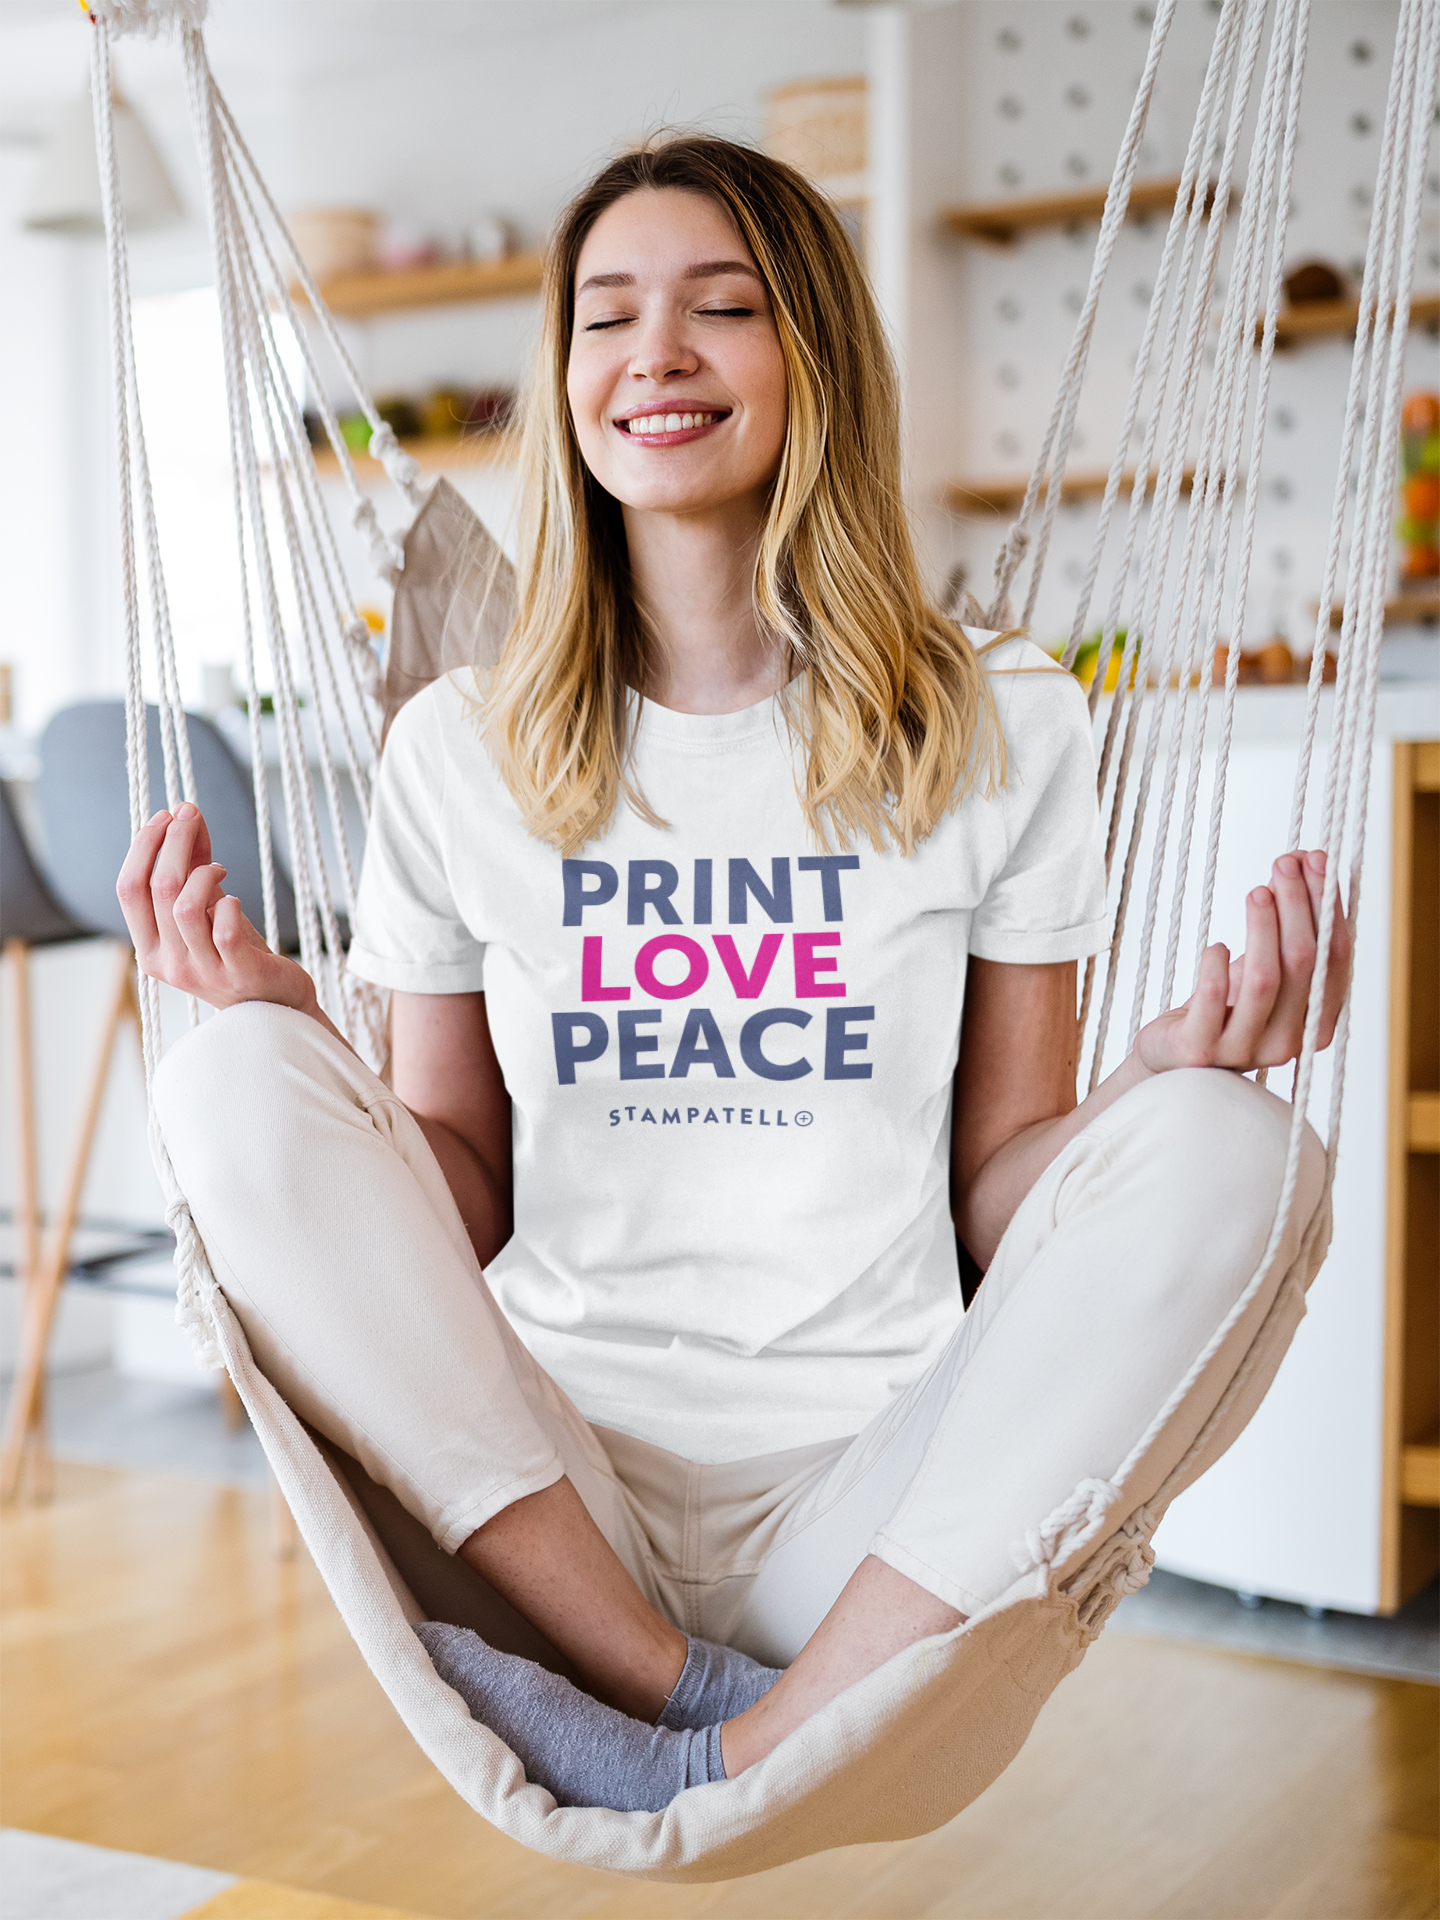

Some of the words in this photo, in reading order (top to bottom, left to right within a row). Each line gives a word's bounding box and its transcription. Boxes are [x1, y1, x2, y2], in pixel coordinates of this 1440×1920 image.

[562, 855, 860, 926] PRINT
[581, 932, 847, 1002] LOVE
[551, 1006, 875, 1085] PEACE
